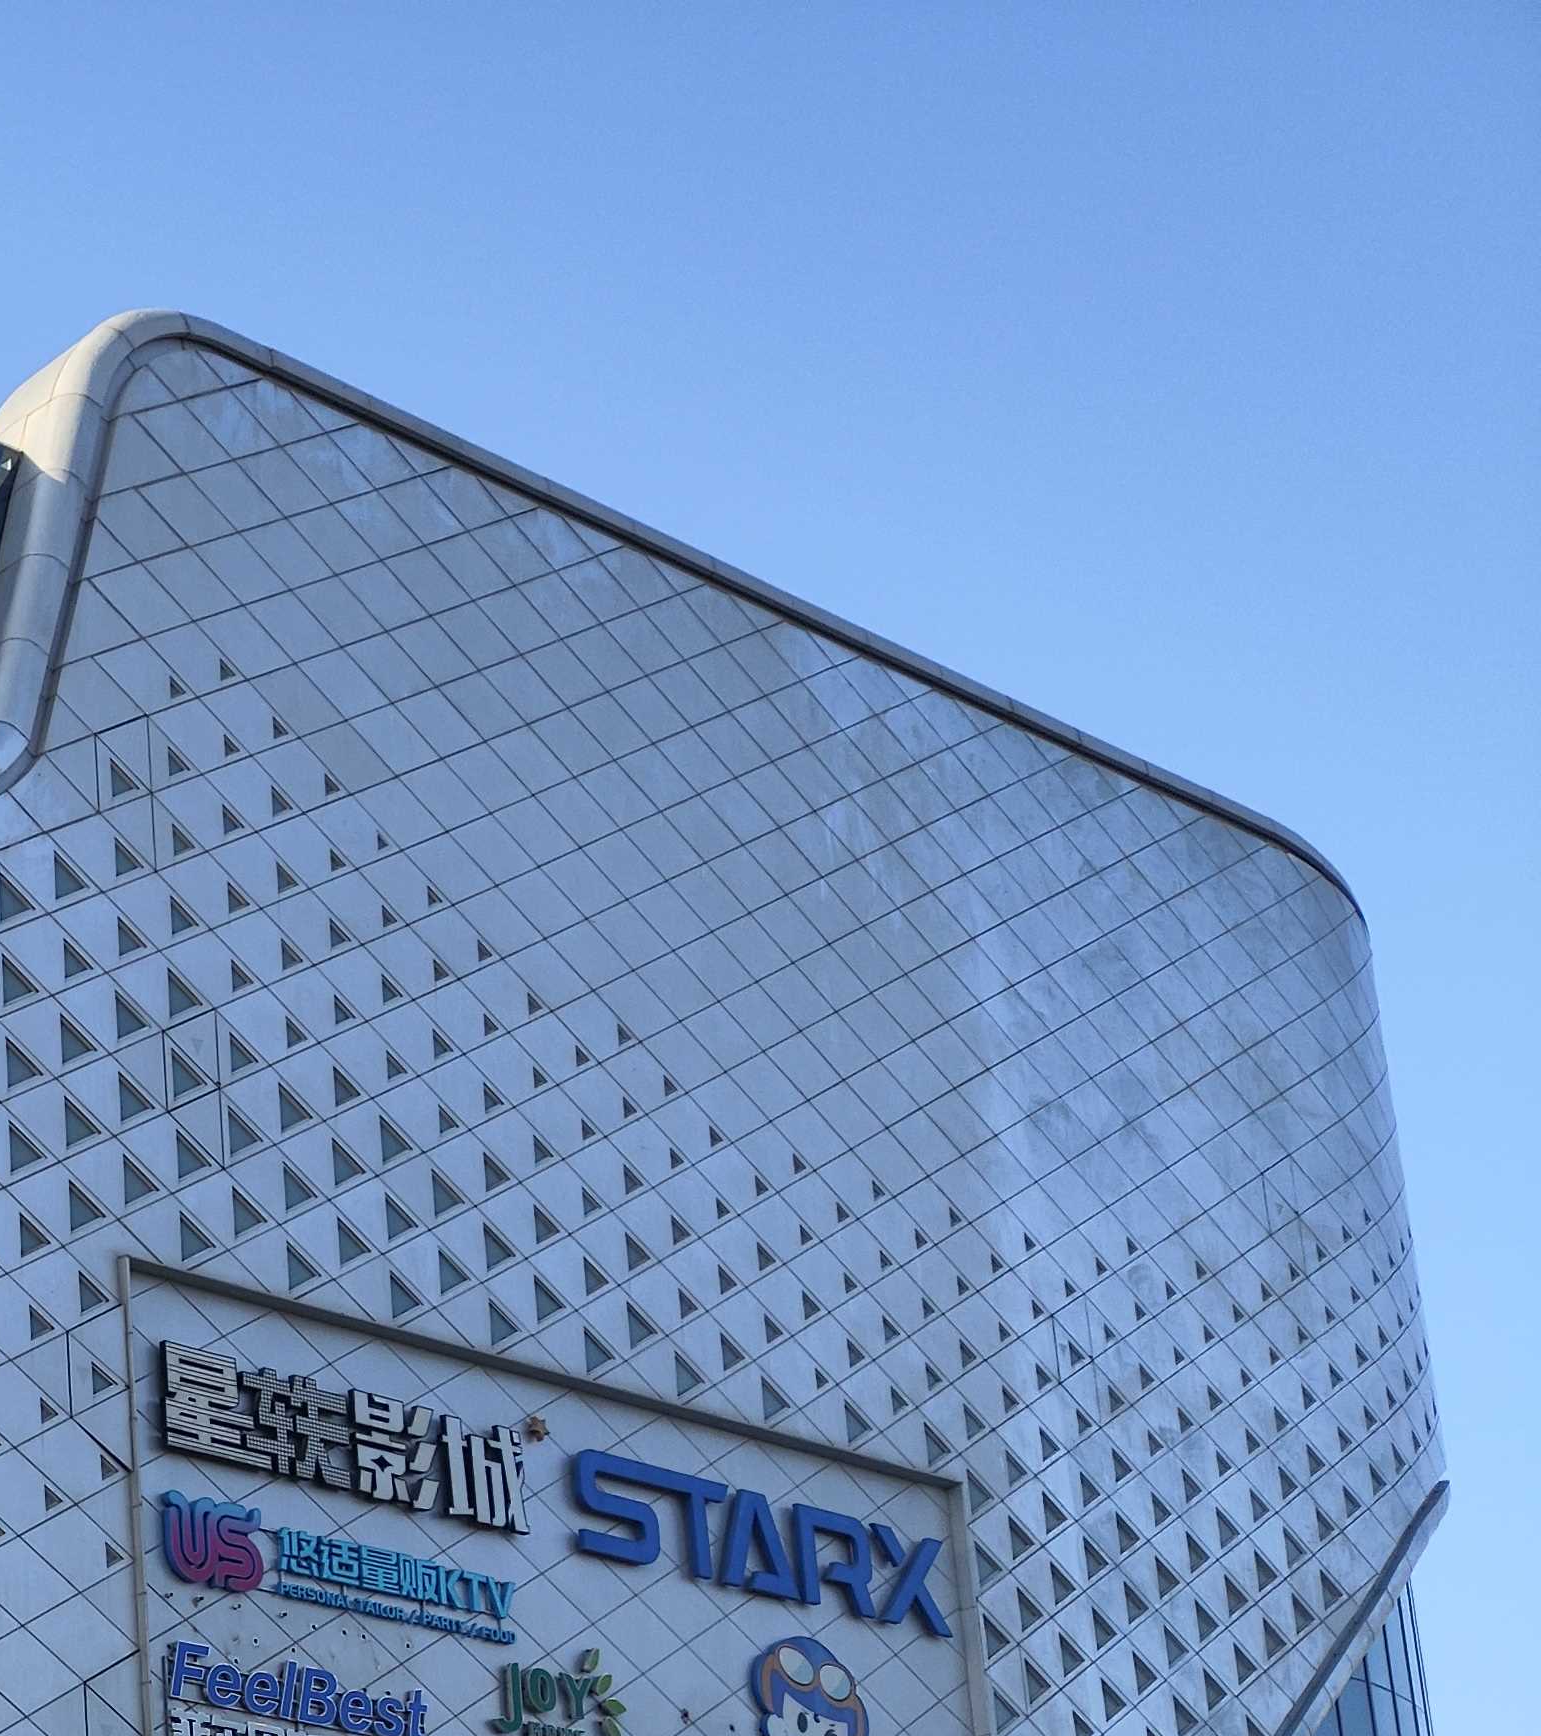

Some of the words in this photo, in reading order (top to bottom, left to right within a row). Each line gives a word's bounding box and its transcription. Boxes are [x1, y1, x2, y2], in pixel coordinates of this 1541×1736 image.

[160, 1340, 531, 1536] 星轶影城
[572, 1448, 953, 1639] STARX
[276, 1582, 354, 1611] PERSONAL
[355, 1597, 405, 1622] TAILOR
[421, 1611, 462, 1635] PARTY
[482, 1626, 517, 1646] FOOD
[491, 1661, 597, 1734] JOY
